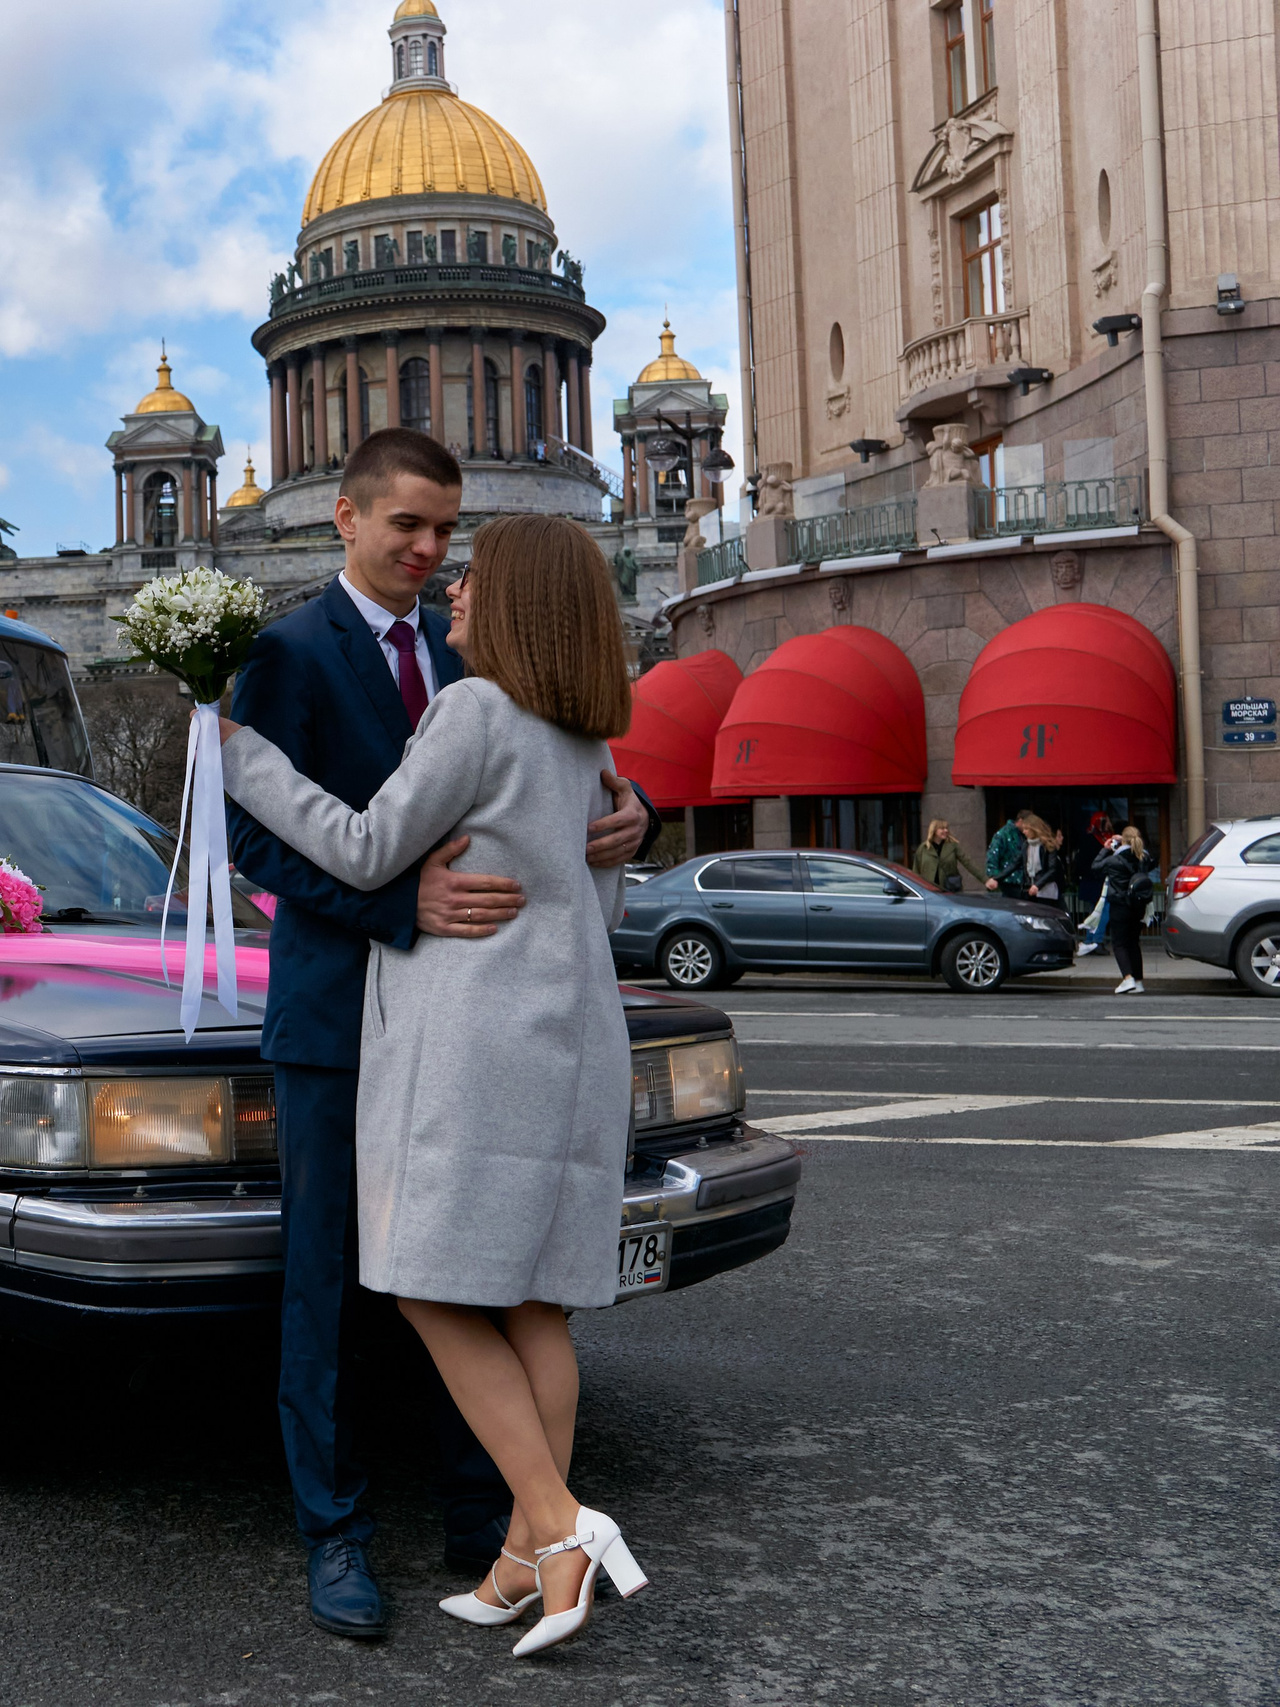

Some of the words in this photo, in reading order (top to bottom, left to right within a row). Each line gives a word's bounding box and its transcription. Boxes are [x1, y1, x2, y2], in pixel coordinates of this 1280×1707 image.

[1230, 703, 1269, 711] БОЛЬШАЯ
[1244, 732, 1255, 741] 39
[618, 1234, 658, 1274] 178
[619, 1272, 643, 1288] RUS
